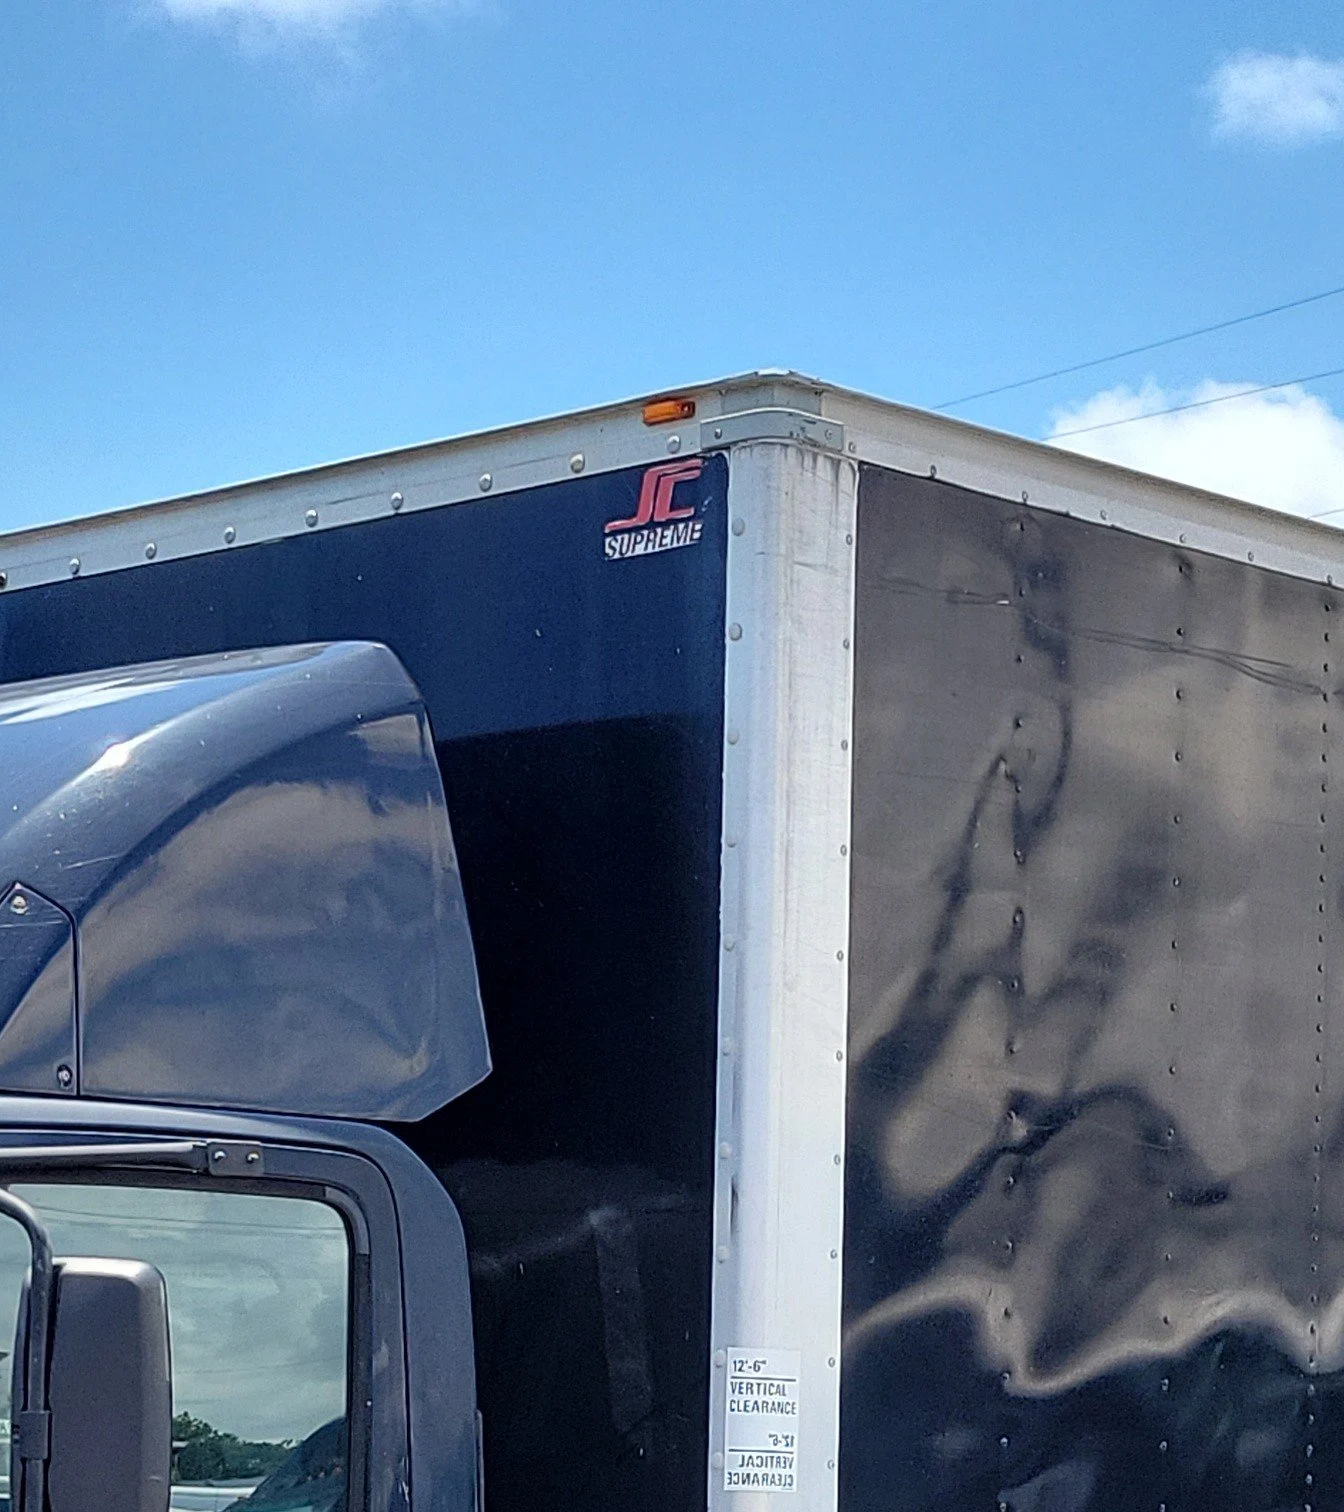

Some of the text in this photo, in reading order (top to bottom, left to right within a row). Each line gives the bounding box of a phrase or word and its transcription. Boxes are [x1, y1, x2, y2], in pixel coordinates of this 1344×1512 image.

[605, 522, 703, 560] SUPREME
[730, 1381, 787, 1397] VERTICAL
[729, 1400, 796, 1415] CLEARANCE
